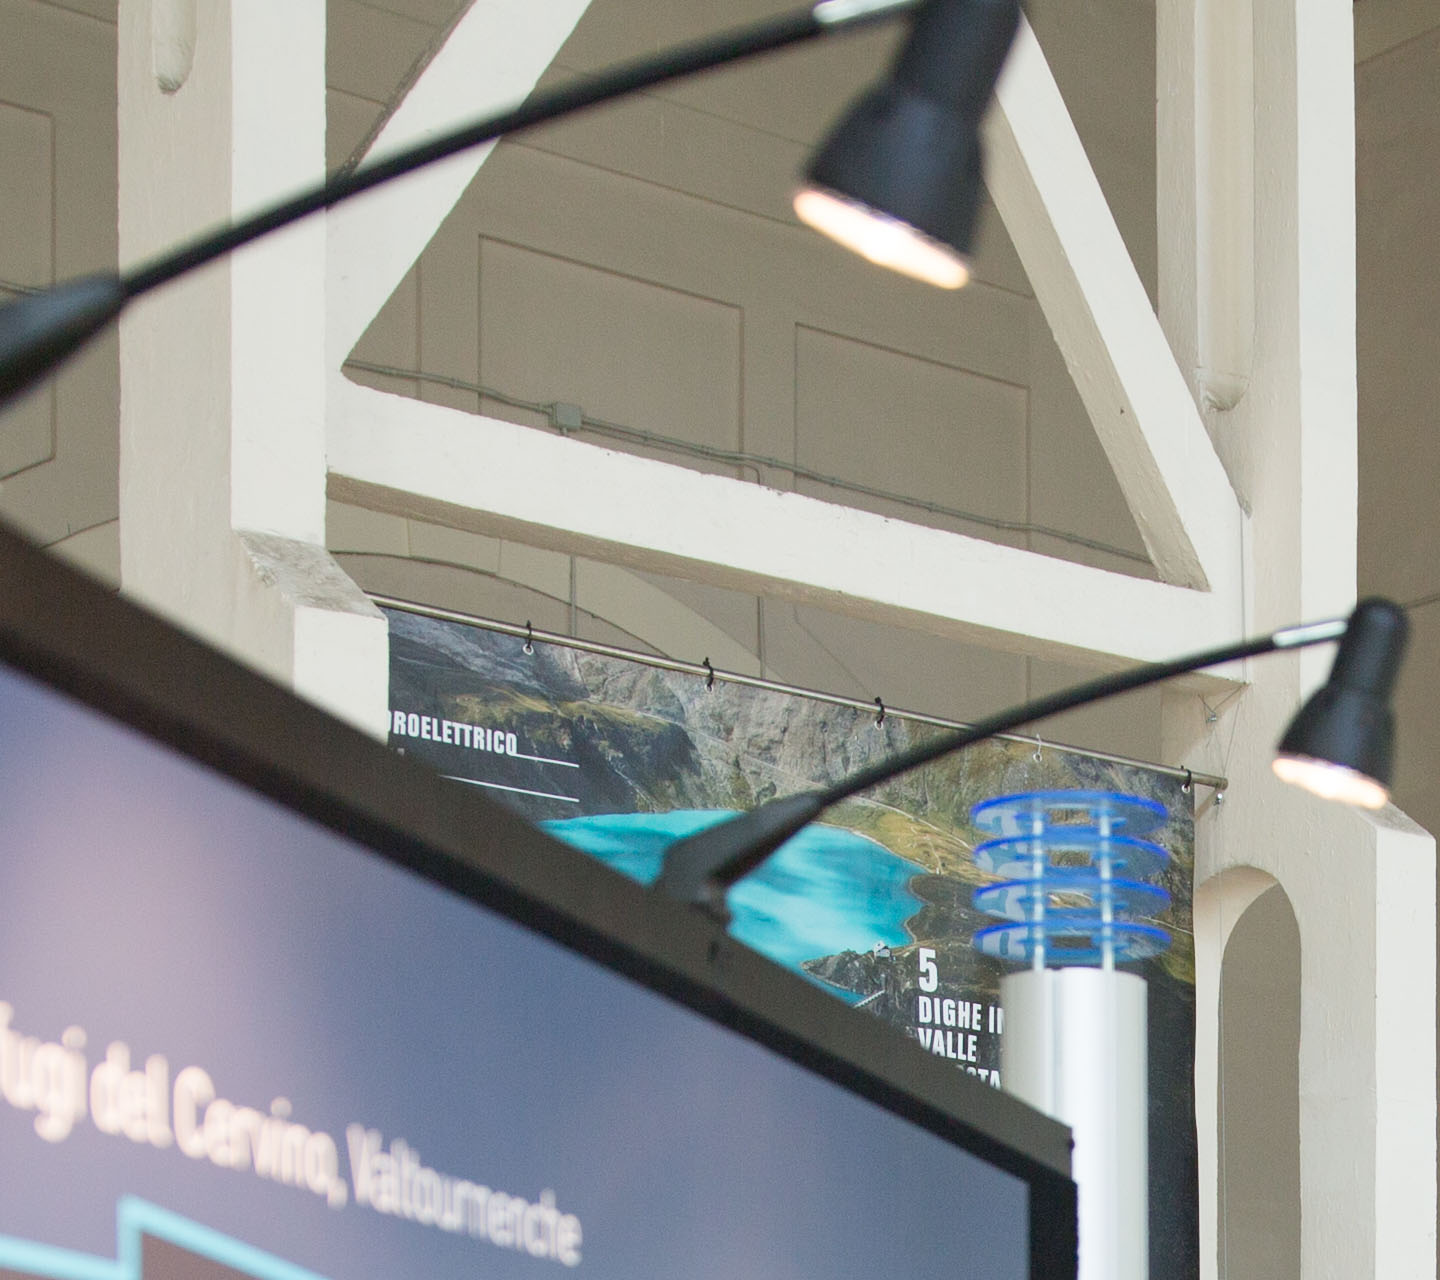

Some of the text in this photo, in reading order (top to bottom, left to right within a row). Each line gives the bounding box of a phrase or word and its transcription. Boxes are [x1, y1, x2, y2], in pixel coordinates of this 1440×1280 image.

[918, 947, 939, 993] 5
[918, 995, 982, 1031] DIGHE
[917, 1027, 978, 1063] VALLE
[89, 1039, 174, 1149] del
[173, 1065, 348, 1212] Cervino,
